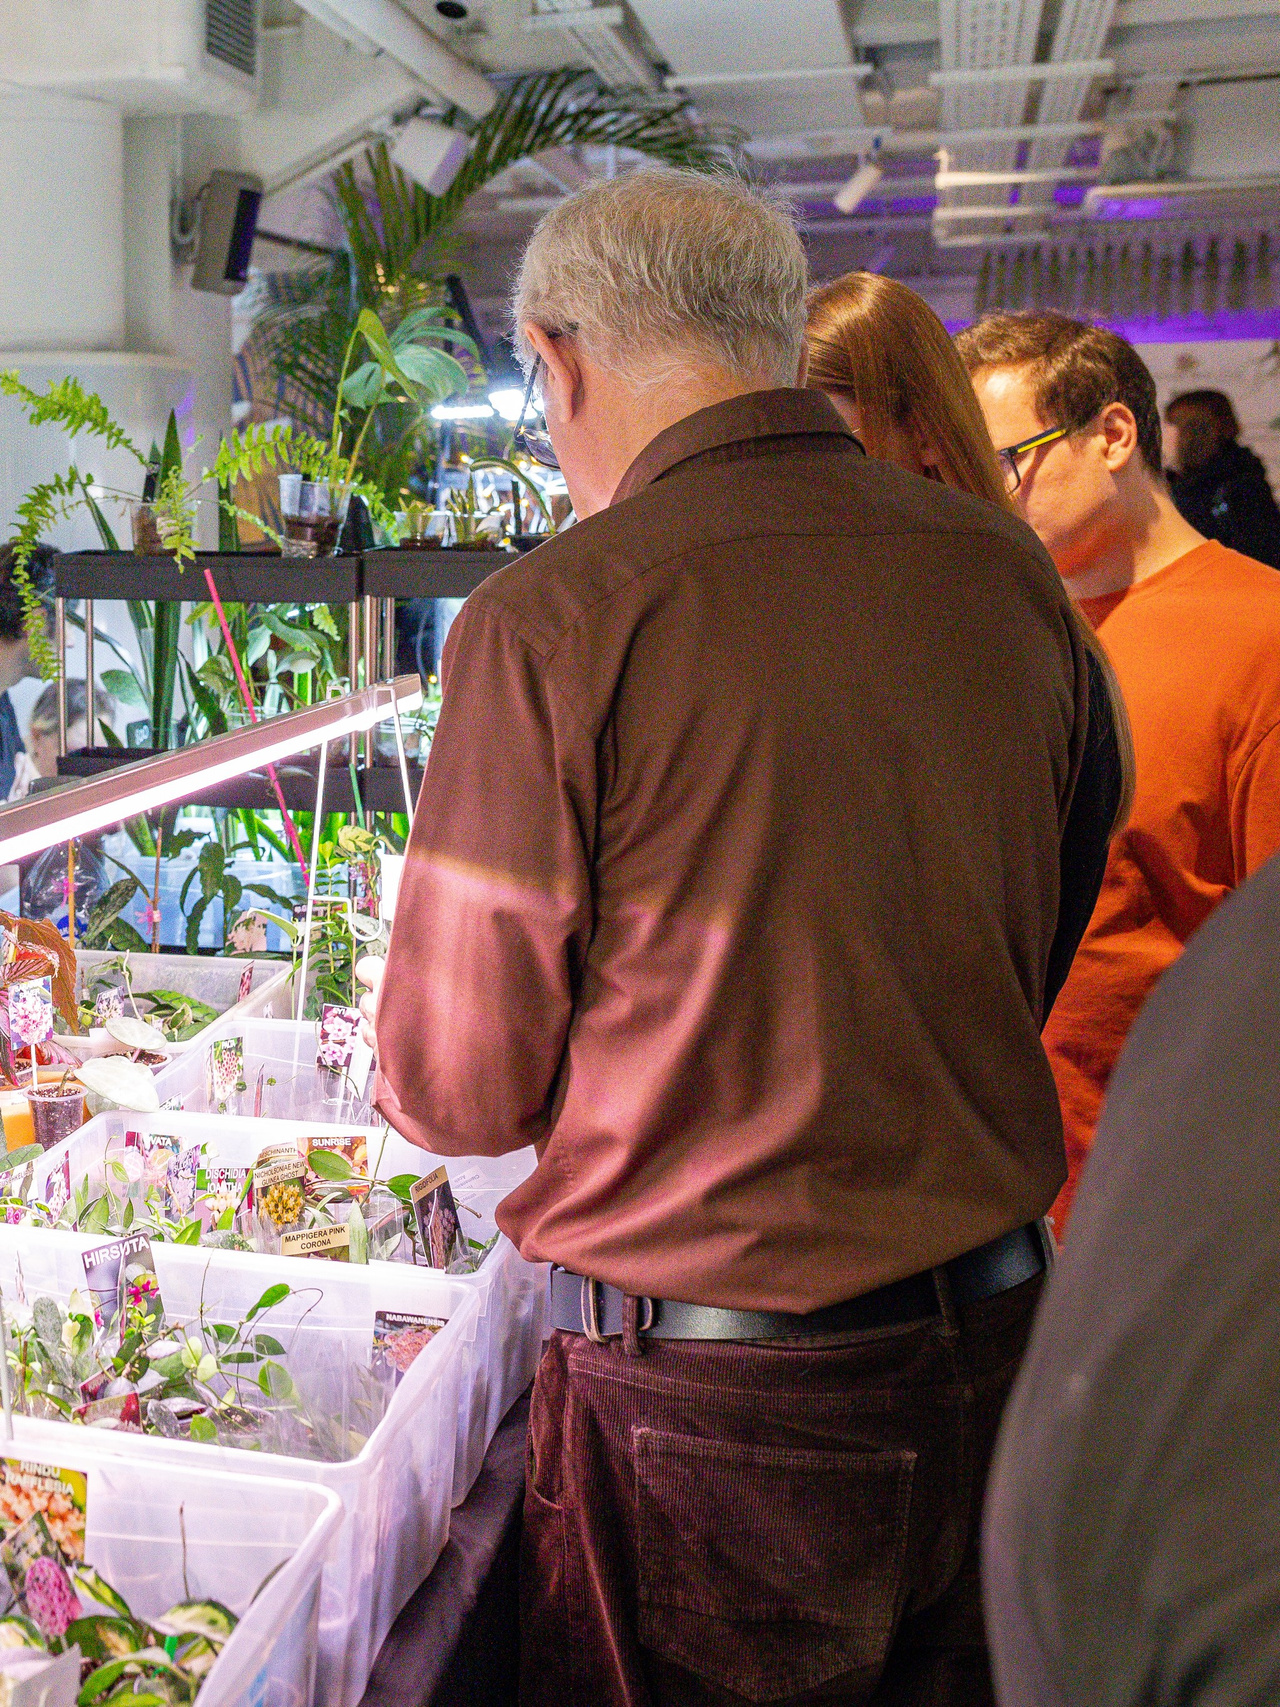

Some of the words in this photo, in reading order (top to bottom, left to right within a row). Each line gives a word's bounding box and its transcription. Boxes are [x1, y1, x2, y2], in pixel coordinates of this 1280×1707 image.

[312, 1138, 351, 1147] SUNRISE
[206, 1168, 247, 1179] DISCHIDIA
[254, 1162, 292, 1179] NICHOLSONIAE
[292, 1160, 305, 1169] NEW
[261, 1176, 280, 1187] GUINEA
[280, 1170, 299, 1181] GHOST
[284, 1230, 328, 1243] MAPPIGERA
[329, 1226, 346, 1235] PINK
[83, 1236, 150, 1269] HIRSUTA
[300, 1238, 331, 1250] CORONA
[385, 1313, 445, 1327] NABAWANENSIS
[20, 1460, 61, 1479] RINDU
